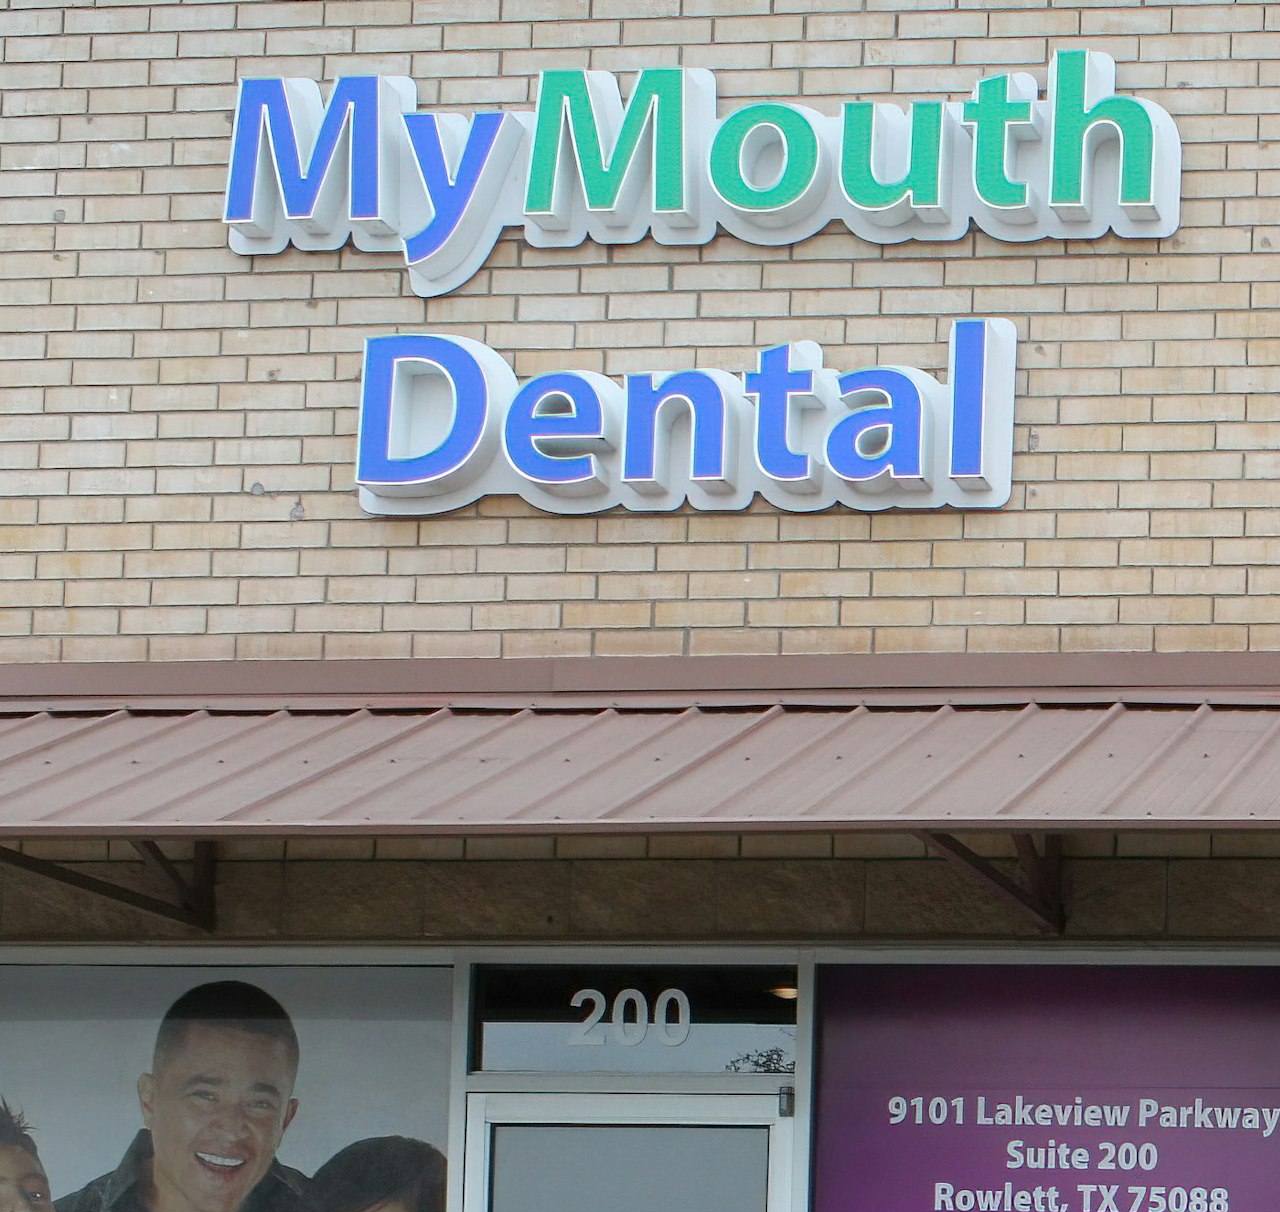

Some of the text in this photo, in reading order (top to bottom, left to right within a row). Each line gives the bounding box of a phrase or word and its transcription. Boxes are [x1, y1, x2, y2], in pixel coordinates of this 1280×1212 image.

[222, 48, 1160, 266] MyMouth
[354, 318, 987, 486] Dental
[568, 987, 692, 1048] 200
[888, 1095, 1280, 1138] 9101 Lakeview Parkway
[1006, 1140, 1158, 1171] Suite 200
